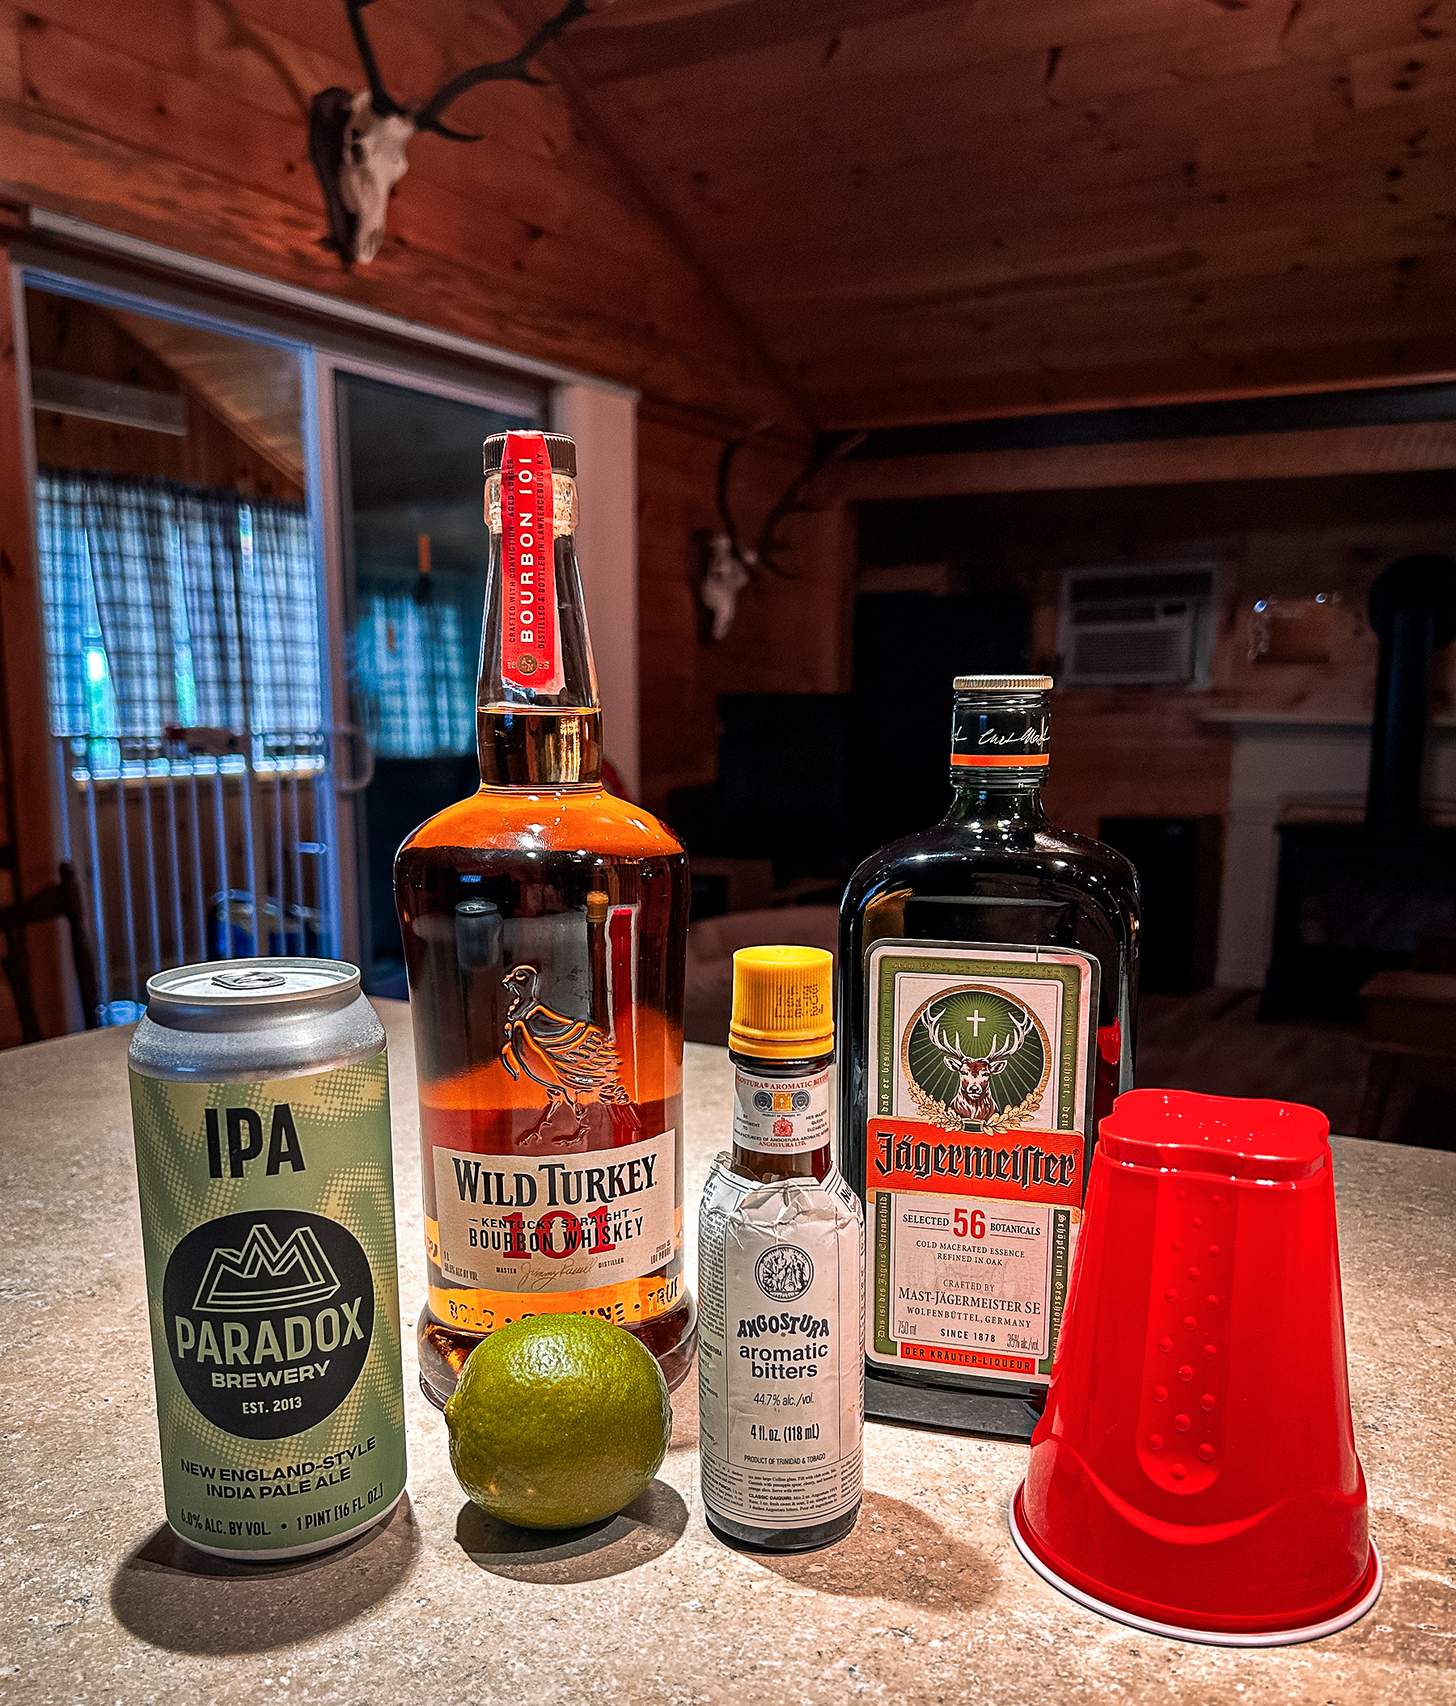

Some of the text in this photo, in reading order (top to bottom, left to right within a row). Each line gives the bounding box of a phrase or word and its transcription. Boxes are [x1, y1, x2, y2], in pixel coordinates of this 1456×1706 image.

[536, 453, 544, 465] KY
[518, 458, 533, 495] 101
[519, 512, 534, 643] BOURBON
[537, 555, 545, 593] BOTTLED
[508, 582, 516, 603] WITH
[508, 606, 516, 643] CRAFTED
[537, 605, 545, 649] DISTILLED
[769, 1081, 813, 1090] AROMATIC
[882, 1078, 889, 1089] er
[1061, 1105, 1071, 1127] den
[206, 1103, 306, 1179] IPA
[759, 1140, 794, 1148] ANGOSTURA
[452, 1157, 537, 1207] WILD
[481, 1208, 629, 1229] KENTUCKY STRAIGHT
[902, 1207, 1041, 1239] SELECTED 56 BOTANICALS
[469, 1227, 553, 1252] BOURBON
[563, 1216, 643, 1250] WHISKEY
[502, 1205, 616, 1259] 101
[916, 1240, 1025, 1258] COLD MACERATED ESSENCE
[937, 1253, 1003, 1266] REFINED IN OAK
[598, 1257, 625, 1269] DISTILLER
[1056, 1264, 1065, 1277] im
[943, 1279, 995, 1293] CRAFTED BY
[898, 1287, 1041, 1315] MAST-JÄGERMEISTER SE
[737, 1312, 830, 1338] ANGOSTURA
[897, 1320, 910, 1335] 750
[907, 1306, 1031, 1328] WOLFENBÜTTEL, GERMANY
[175, 1296, 365, 1365] PARADOX
[940, 1328, 996, 1343] SINCE 1878
[739, 1343, 829, 1362] aromatic
[905, 1346, 1031, 1370] DER KRÄUTER-LIQUEUR
[211, 1359, 330, 1389] BREWERY
[751, 1361, 818, 1380] bitters
[242, 1396, 303, 1415] EST. 2013
[753, 1393, 781, 1406] 44.7%
[750, 1424, 757, 1441] 4
[783, 1425, 803, 1444] (118
[804, 1423, 820, 1440] mL)
[181, 1436, 376, 1482] NEW ENGLAND-STYLE
[744, 1452, 826, 1465] PRODUCT OF TRINIDAD & TOBAGO
[206, 1467, 351, 1500] INDIA PALE ALE
[181, 1508, 272, 1536] 6.0% ALC. BY VOL.
[296, 1516, 302, 1531] 1
[305, 1509, 332, 1530] PINT
[352, 1498, 366, 1514] FL.
